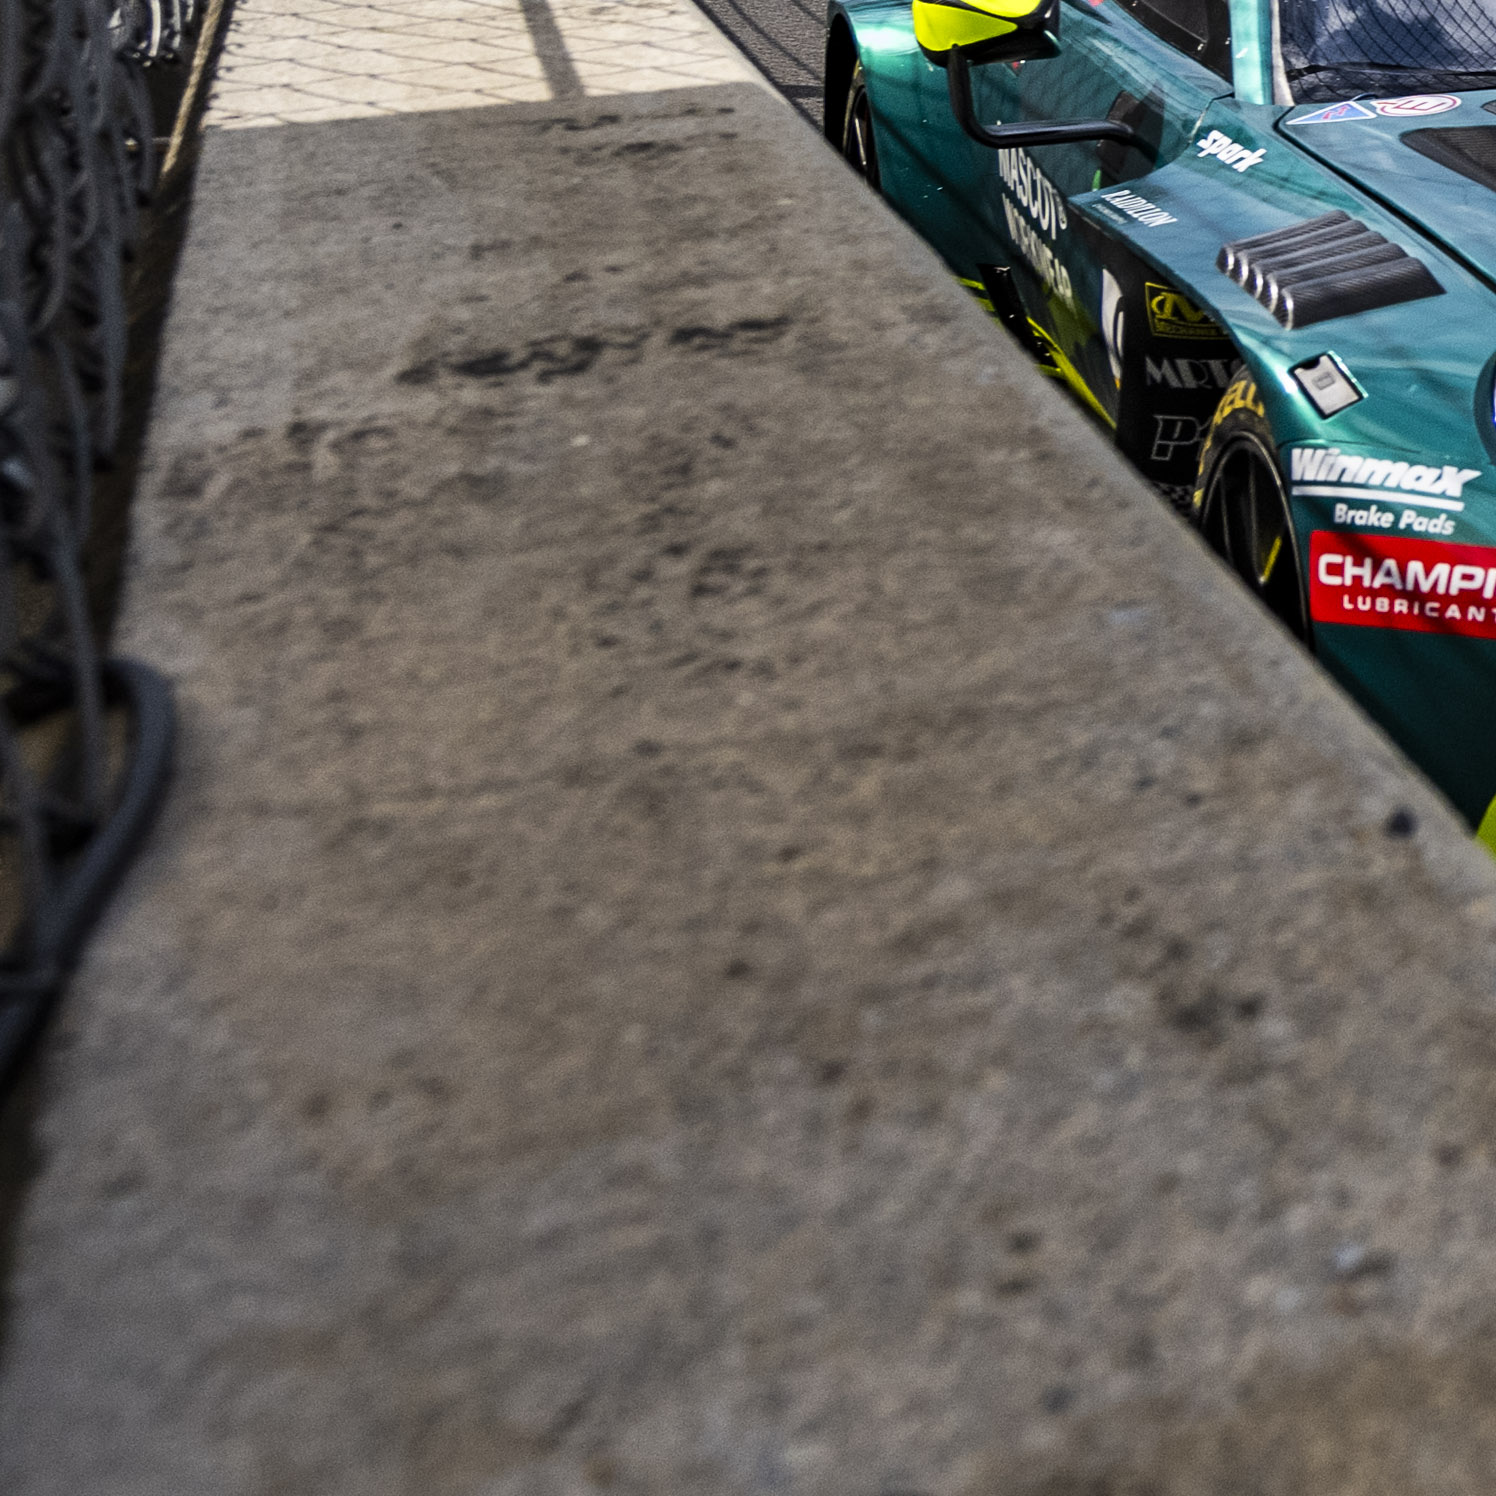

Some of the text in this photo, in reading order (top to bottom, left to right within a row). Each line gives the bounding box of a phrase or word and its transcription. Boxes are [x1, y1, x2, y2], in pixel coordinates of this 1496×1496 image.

[1101, 189, 1178, 227] RAIDILLON
[1333, 503, 1456, 535] Brake Pads
